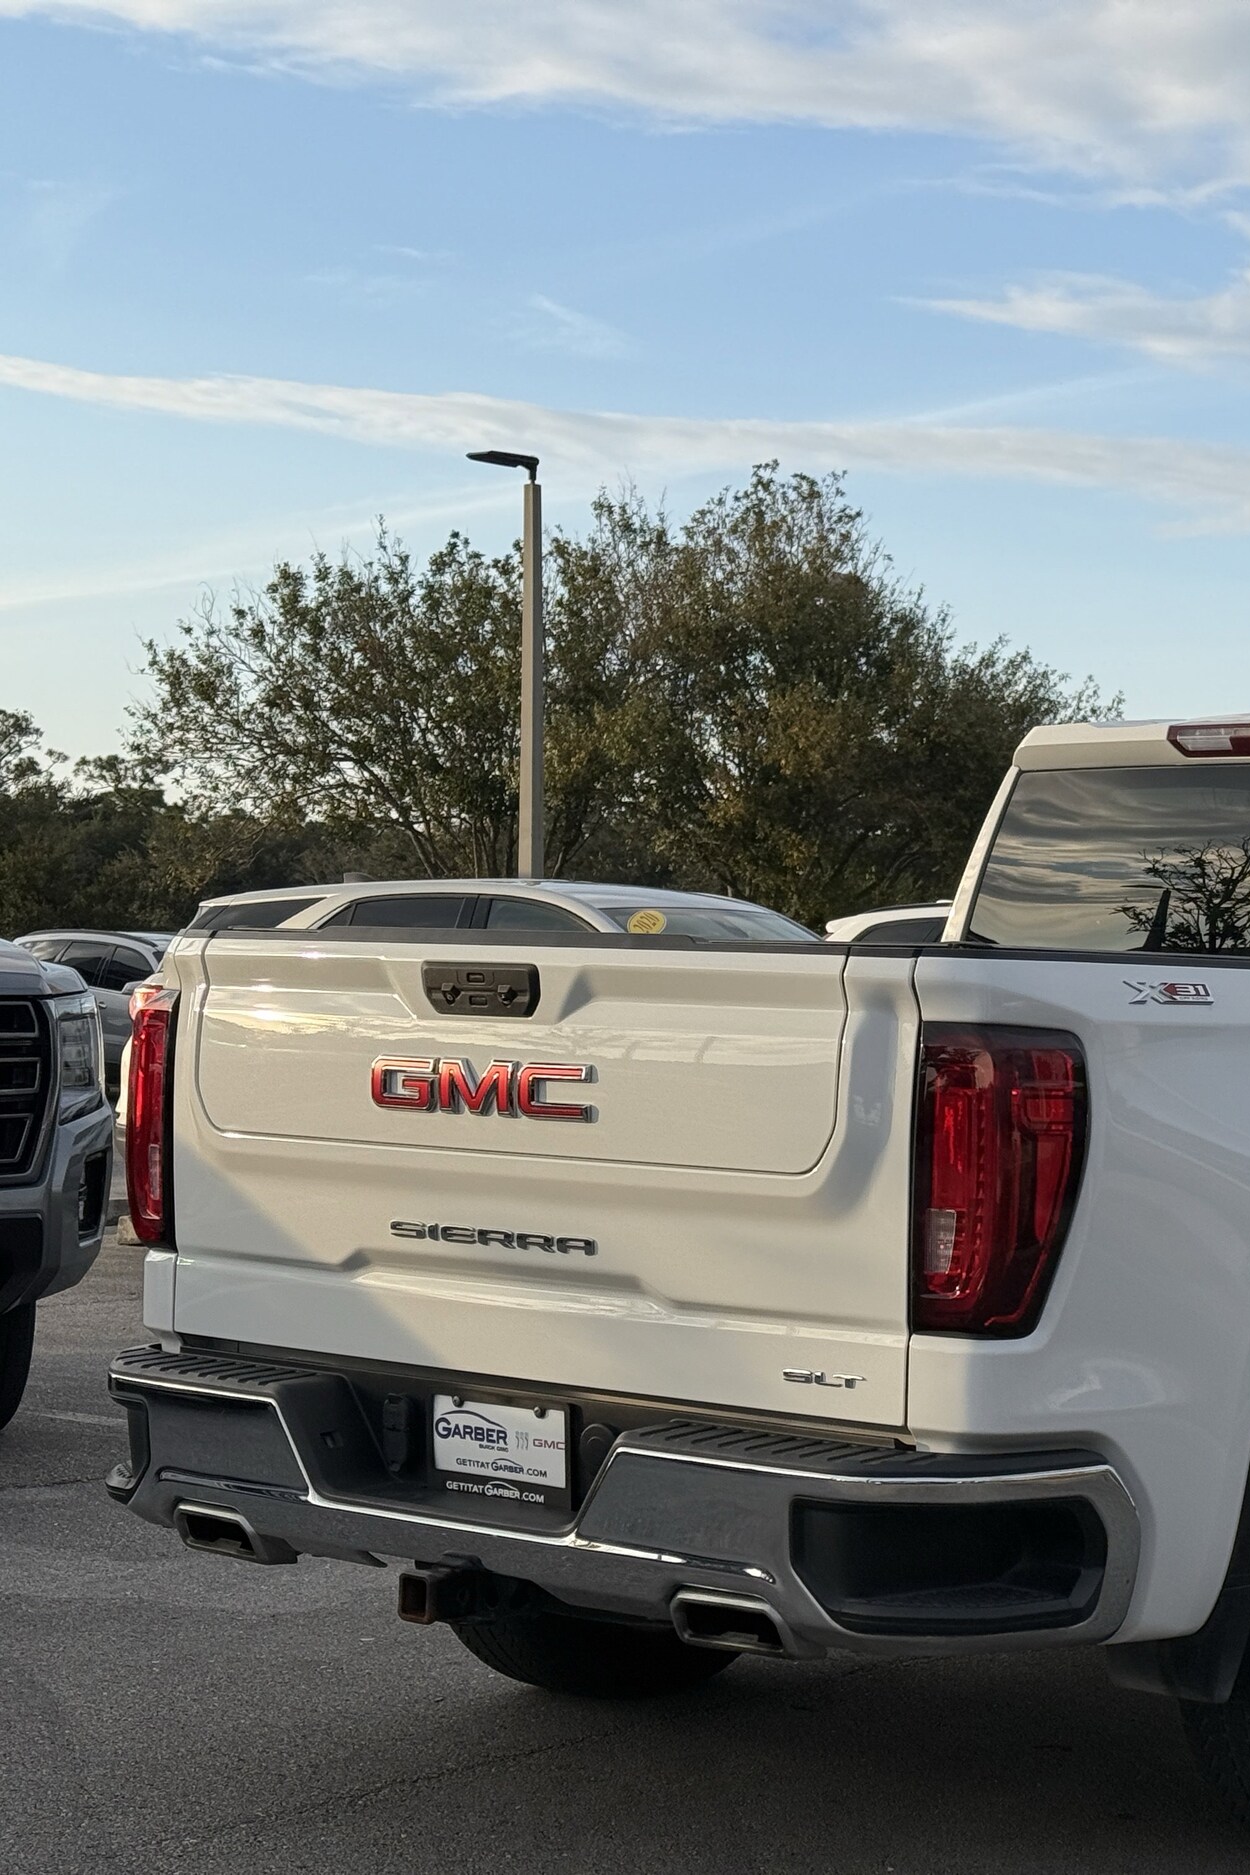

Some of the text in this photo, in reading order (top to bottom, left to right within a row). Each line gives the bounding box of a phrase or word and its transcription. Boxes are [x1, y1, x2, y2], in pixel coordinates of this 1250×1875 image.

[371, 1054, 598, 1123] GMC
[390, 1219, 599, 1256] SIERRA
[782, 1368, 867, 1389] SLT
[435, 1417, 508, 1446] GARBER
[532, 1438, 566, 1451] GMC
